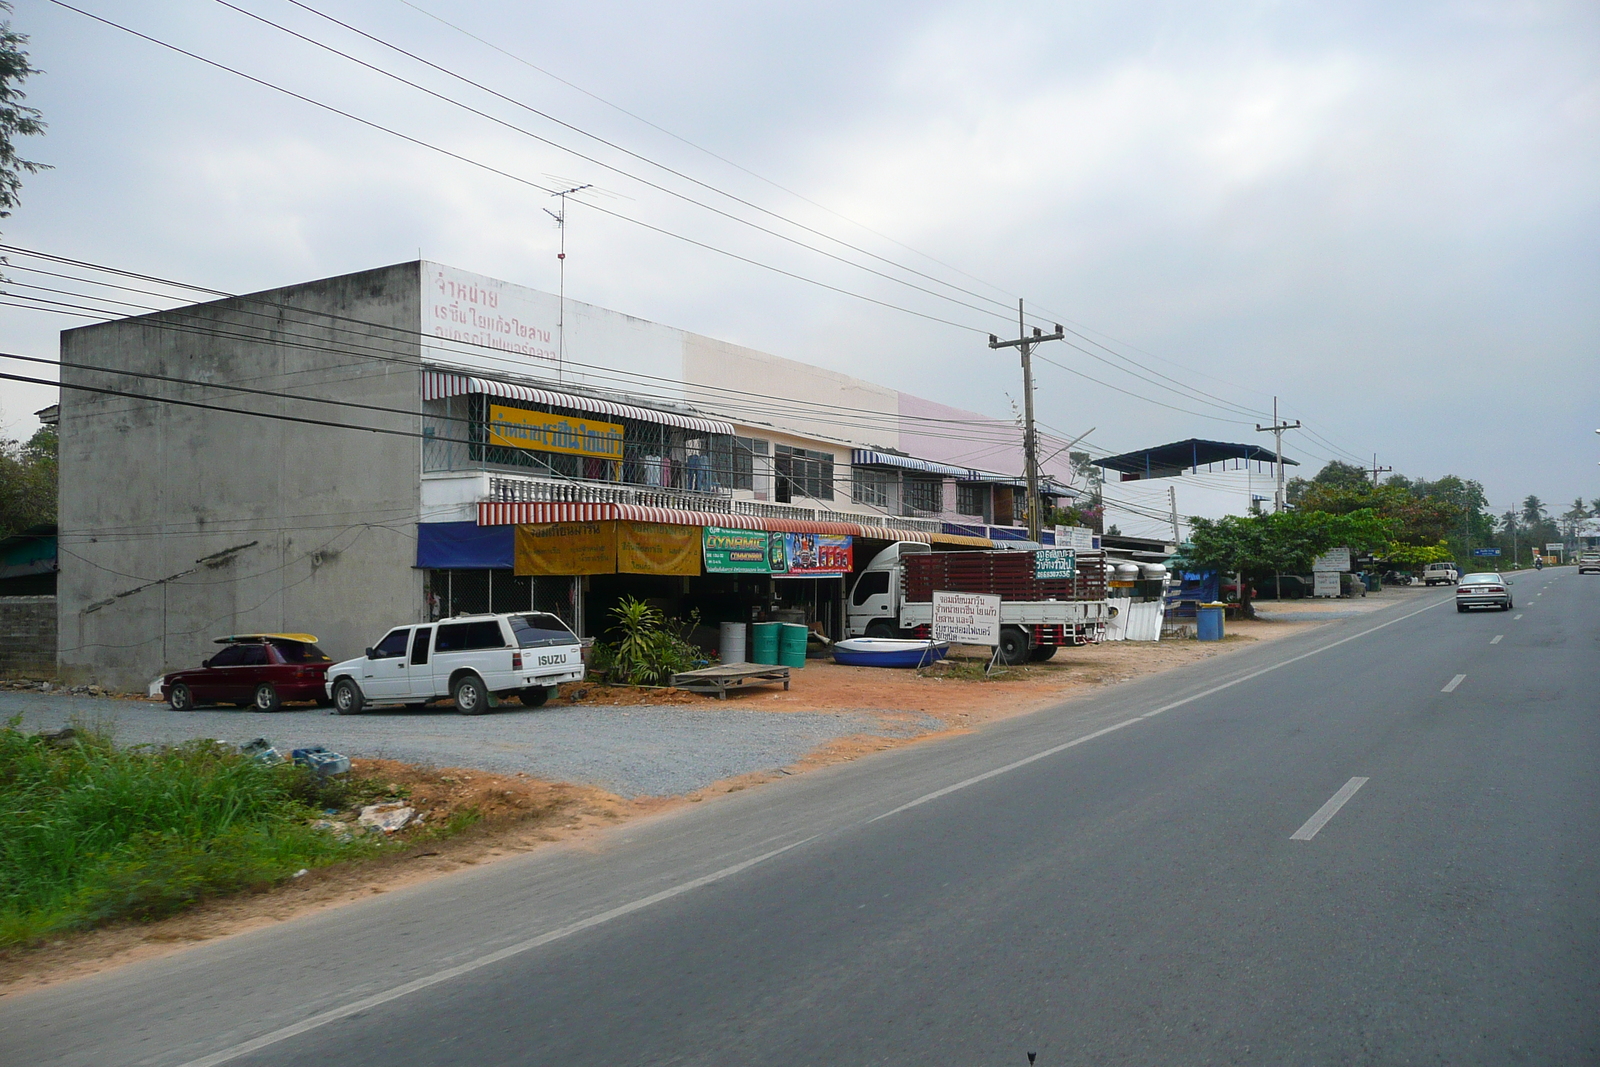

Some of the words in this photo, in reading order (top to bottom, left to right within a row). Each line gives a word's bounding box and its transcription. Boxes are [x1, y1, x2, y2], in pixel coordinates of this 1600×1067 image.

[434, 272, 498, 308] จำหน่าย
[706, 535, 766, 550] DYNAMIC
[538, 654, 567, 666] ISUZU
